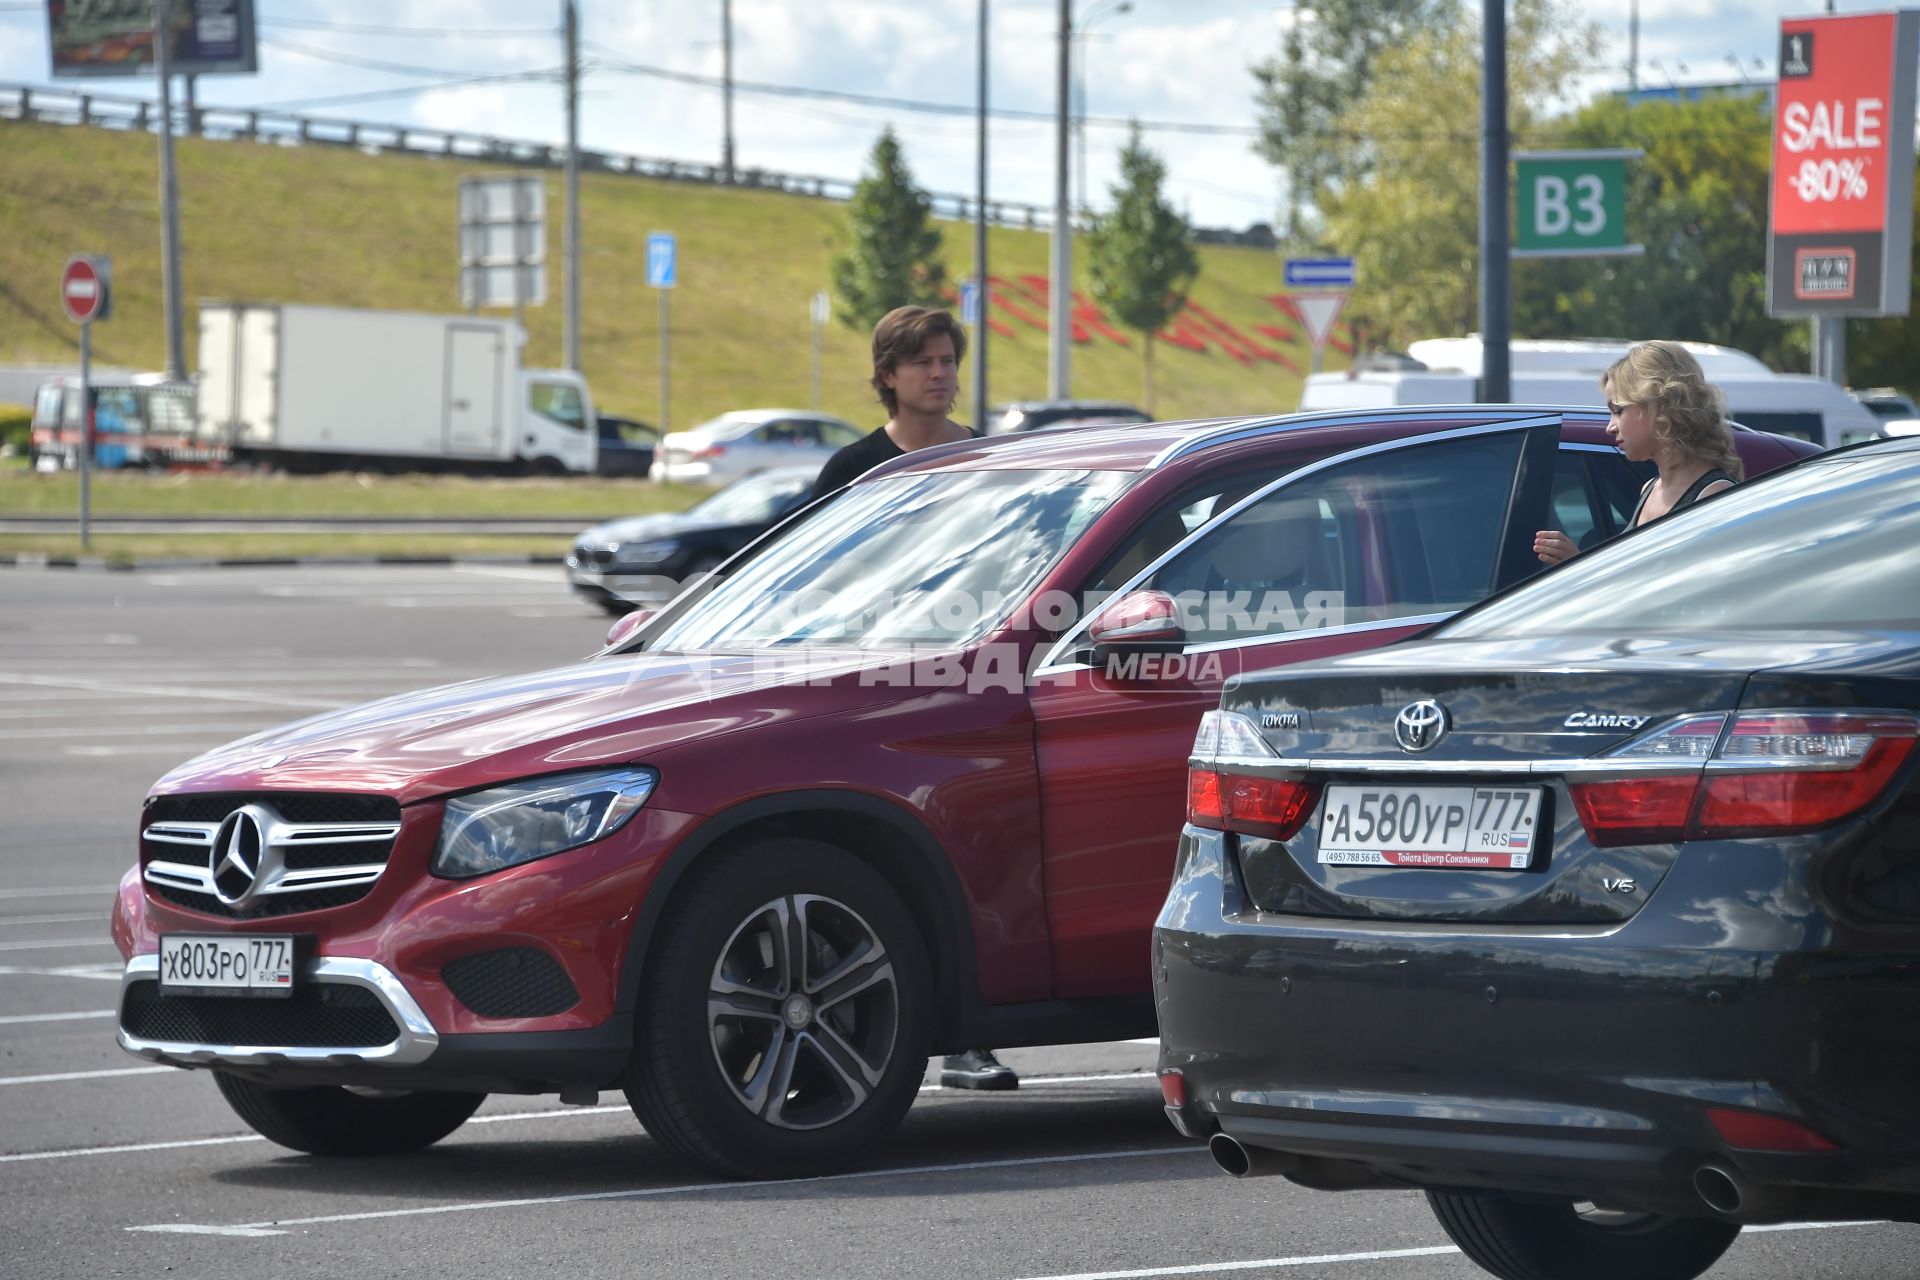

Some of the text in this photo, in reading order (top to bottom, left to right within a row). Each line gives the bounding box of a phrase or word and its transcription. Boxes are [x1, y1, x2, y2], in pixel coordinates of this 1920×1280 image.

[1782, 98, 1882, 152] SALE
[1535, 174, 1607, 236] B3
[1261, 714, 1300, 728] TOYOTA
[1475, 791, 1531, 832] 777
[1481, 832, 1508, 848] RUS
[1326, 851, 1489, 865] (495) 788 56 65 Тойота Центр Сокольники
[1603, 878, 1636, 893] V6
[252, 941, 286, 970] 777
[260, 971, 276, 982] RUS
